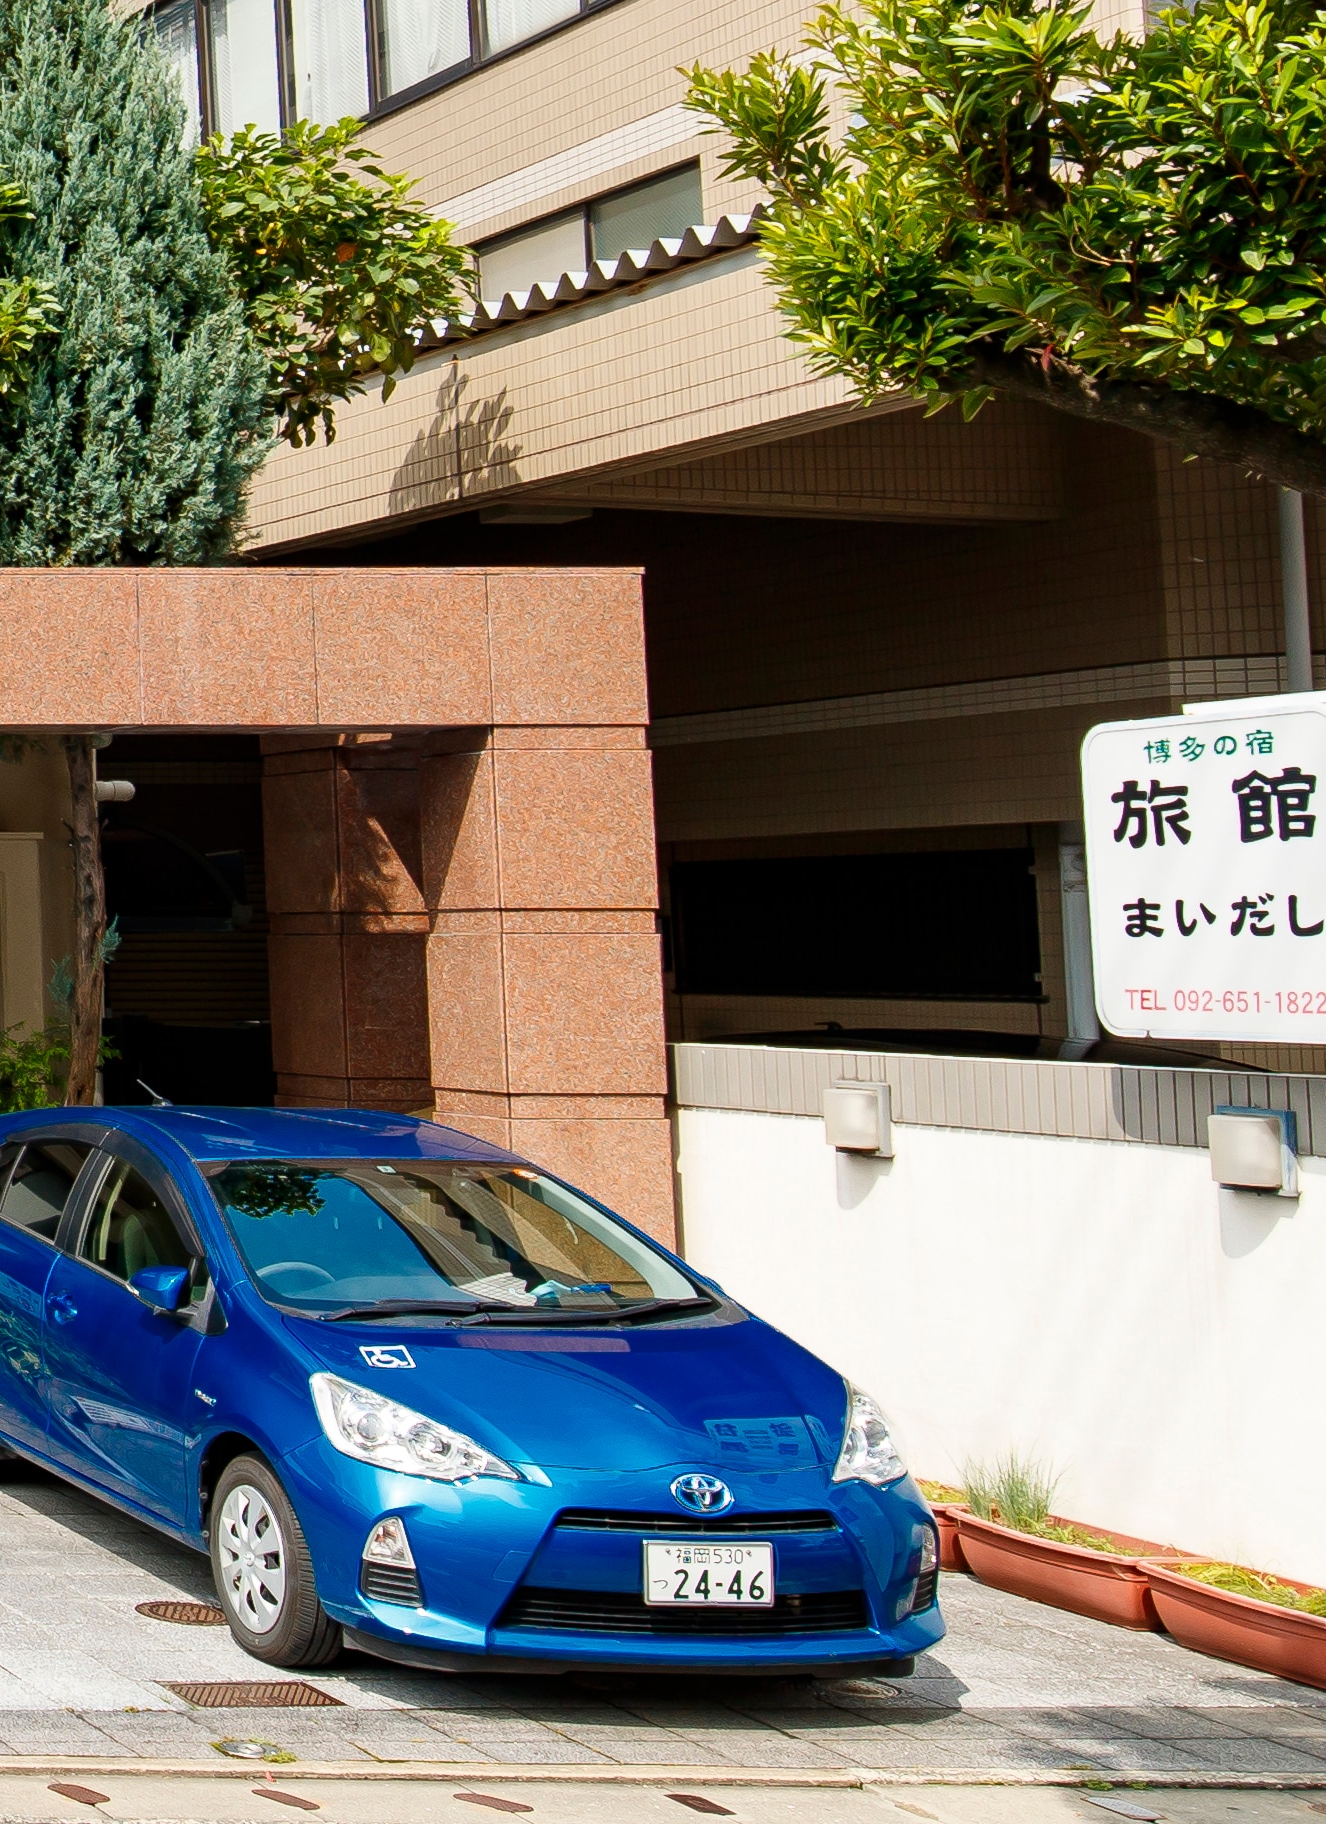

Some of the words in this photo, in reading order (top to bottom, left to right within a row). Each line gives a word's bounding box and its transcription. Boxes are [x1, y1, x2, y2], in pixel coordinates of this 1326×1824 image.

[1143, 729, 1275, 764] 博多の宿
[1110, 766, 1317, 849] 旅館
[1122, 892, 1326, 938] まいだし
[1124, 989, 1167, 1012] TEL
[1174, 989, 1326, 1014] 092-651-1822
[652, 1579, 669, 1590] つ
[673, 1568, 765, 1601] 24-46
